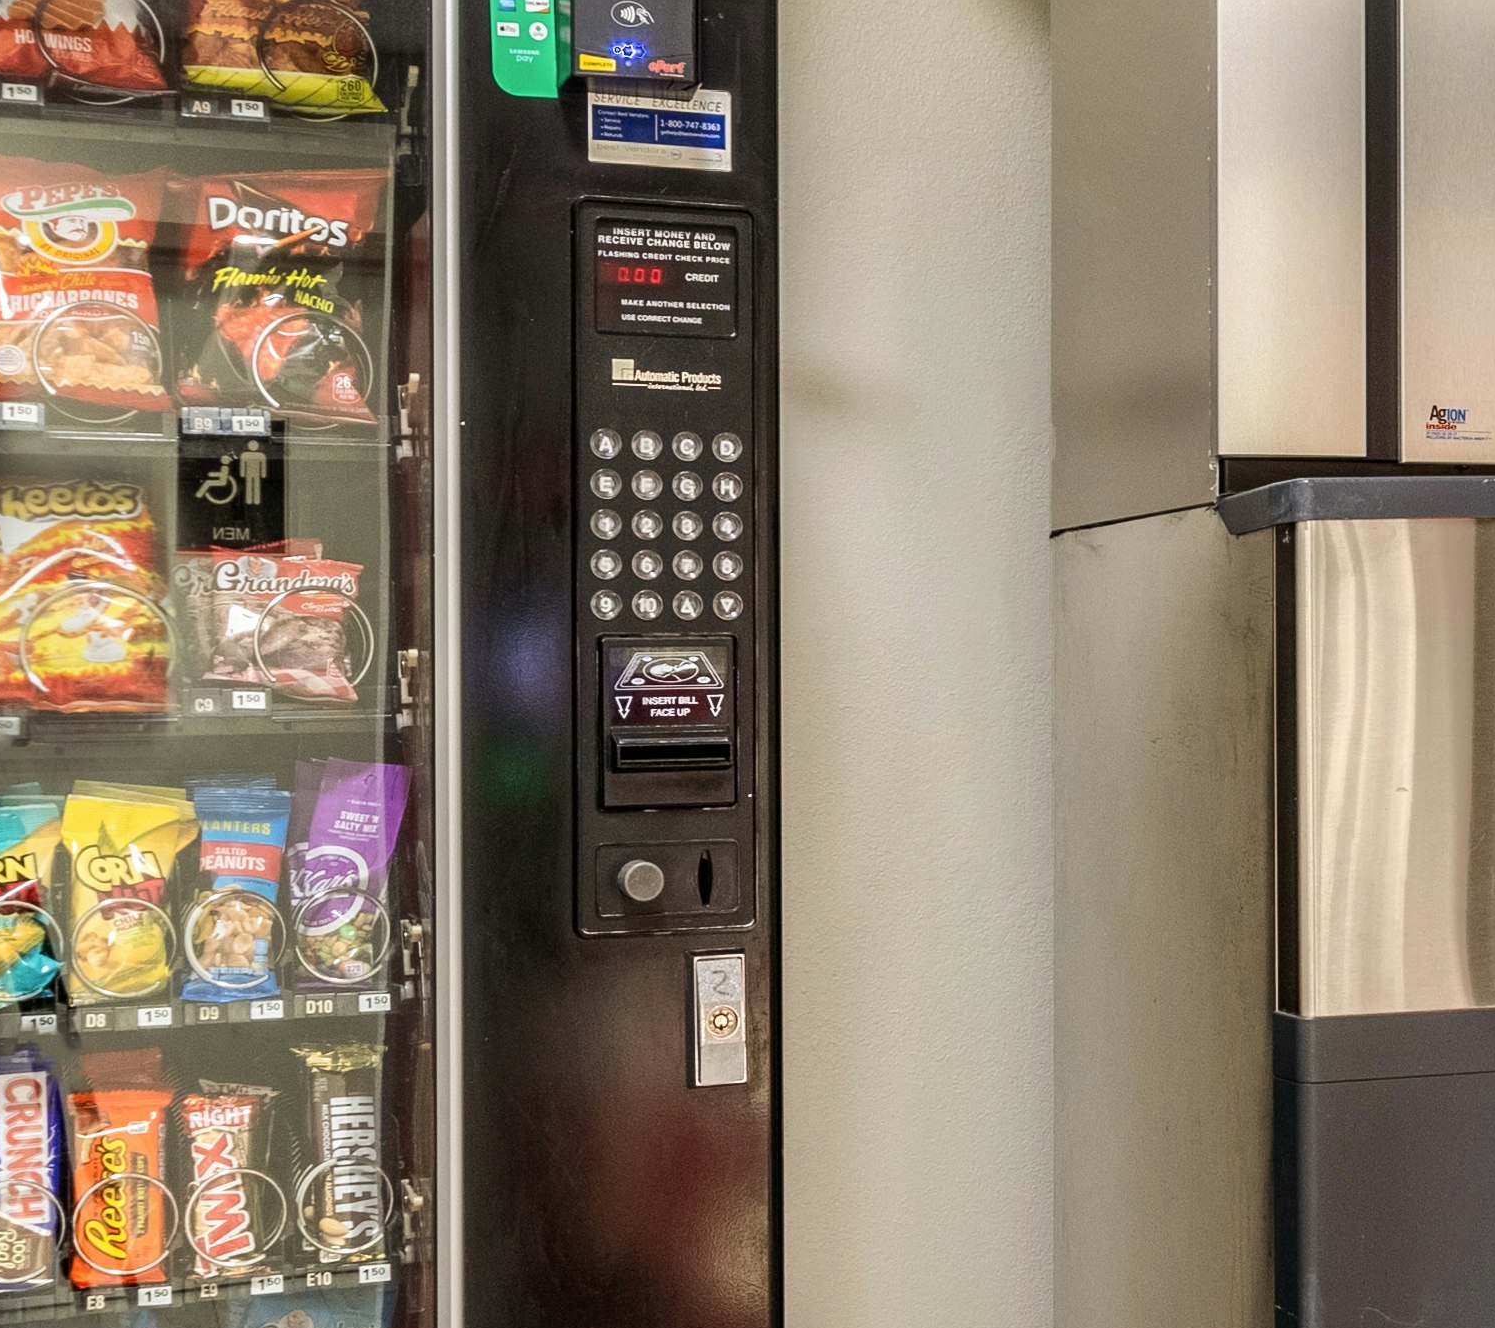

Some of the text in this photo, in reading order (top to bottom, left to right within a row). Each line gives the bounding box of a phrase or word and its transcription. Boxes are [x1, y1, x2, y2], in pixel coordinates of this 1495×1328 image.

[43, 32, 93, 53] WINGS
[340, 78, 362, 92] 260
[192, 100, 211, 114] A9
[594, 92, 723, 113] SERVICE EXCELLENCE
[16, 182, 122, 210] PEPE'S
[208, 197, 349, 248] Doritos
[597, 234, 731, 251] RECEIVE CHANGE BELOW
[612, 227, 716, 242] INSERT MONEY AND
[54, 247, 101, 262] ORIGINAL
[597, 249, 731, 265] FLASHING CREDIT CHECK PRICE
[59, 271, 97, 291] Chile
[212, 265, 328, 293] Flamin' Hot
[685, 272, 720, 284] CREDIT
[293, 289, 335, 315] NACHO
[620, 298, 731, 311] MAKE ANOTHER SELECTION
[621, 313, 703, 325] USE CORRECT CHANGE
[634, 370, 722, 385] Automatic Products
[194, 417, 214, 431] B9
[1425, 421, 1457, 431] inside
[598, 435, 613, 455] A
[639, 437, 654, 454] B
[679, 437, 695, 456] C
[719, 439, 735, 457] D
[599, 475, 614, 494] E
[640, 477, 654, 494] F
[679, 478, 695, 495] G
[720, 479, 736, 497] H
[640, 517, 654, 534] 2
[599, 555, 613, 573] 5
[640, 556, 654, 574] 6
[680, 558, 695, 574] 7
[720, 557, 734, 575] 8
[214, 560, 355, 596] Grandma's
[599, 596, 613, 613] 9
[637, 597, 657, 614] 10
[194, 697, 214, 713] C9
[641, 696, 699, 705] INSERT BILL
[650, 707, 691, 717] FACE UP
[339, 810, 370, 821] SWEET
[333, 820, 379, 833] SALTY MIX
[214, 846, 248, 857] SALTED
[75, 844, 163, 892] CORN
[199, 1006, 220, 1021] D9
[305, 999, 334, 1014] D10
[189, 1104, 253, 1130] RIGHT
[4, 1076, 46, 1220] CRUNCH
[330, 1096, 380, 1239] HERSHEY'S
[84, 1136, 128, 1260] Reese's
[192, 1132, 256, 1278] TWIX
[306, 1272, 332, 1287] E10
[200, 1283, 218, 1298] E9
